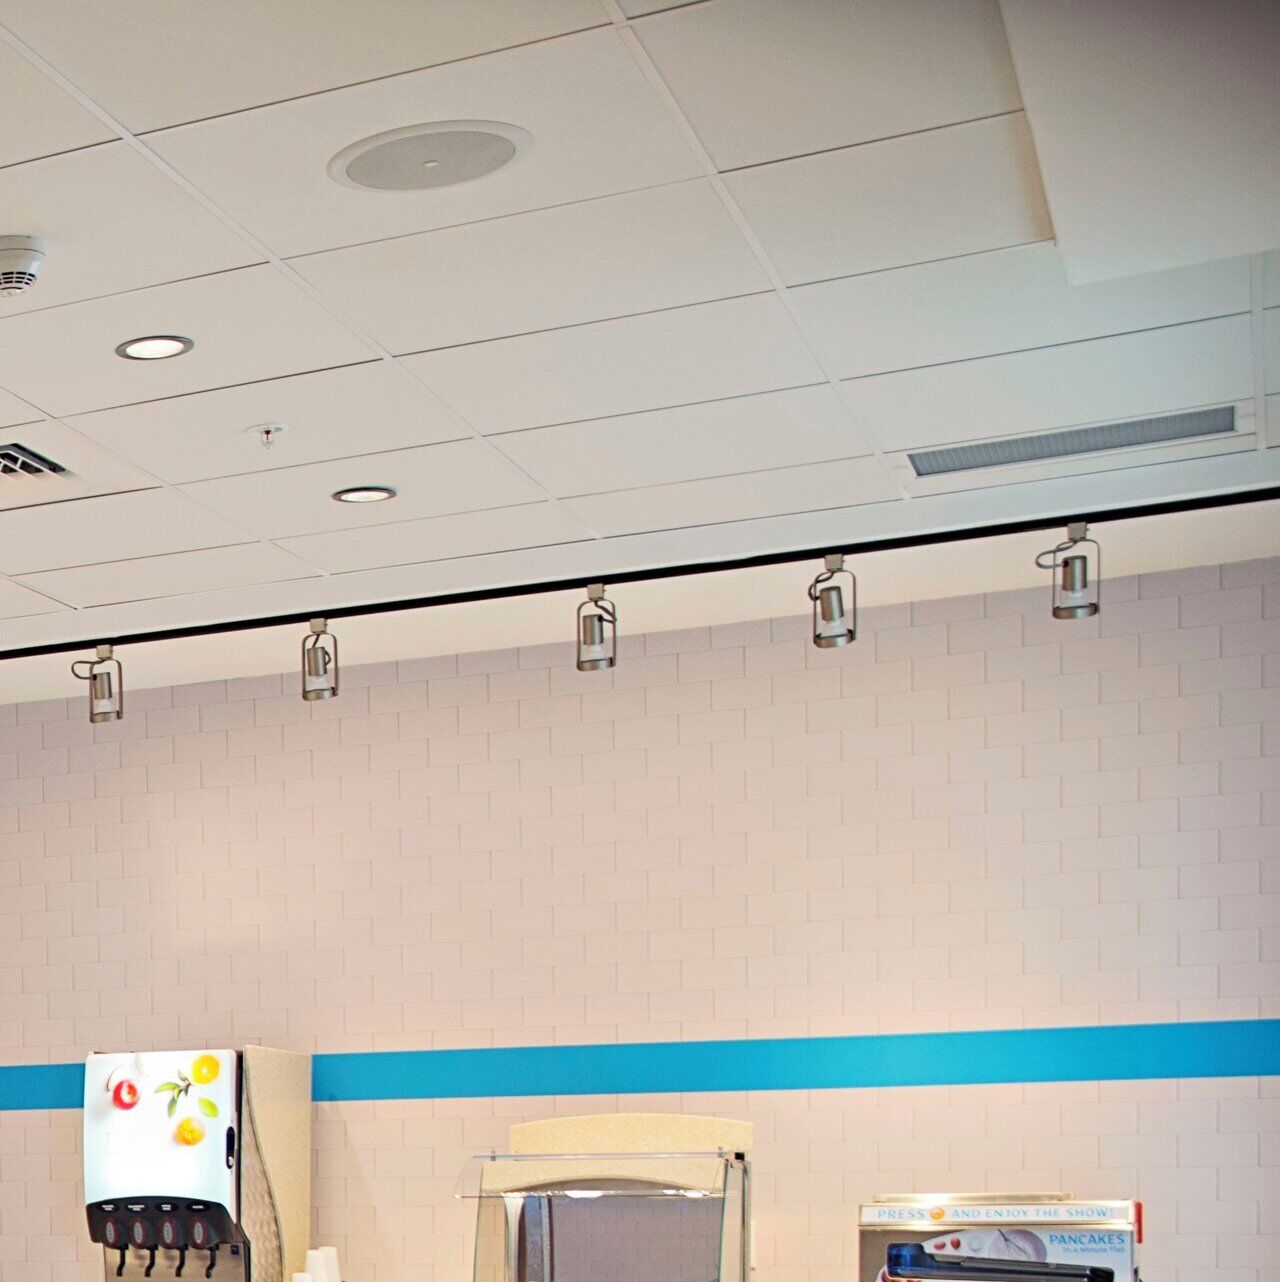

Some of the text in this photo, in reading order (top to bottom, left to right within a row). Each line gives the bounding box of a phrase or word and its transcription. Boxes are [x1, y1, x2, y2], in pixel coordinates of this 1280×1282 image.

[877, 1207, 926, 1219] PRESS
[952, 1207, 981, 1219] AND
[985, 1207, 1029, 1218] ENJOY
[1034, 1207, 1060, 1218] THE
[1066, 1207, 1113, 1218] SHOW!
[1048, 1232, 1126, 1246] PANCAKES
